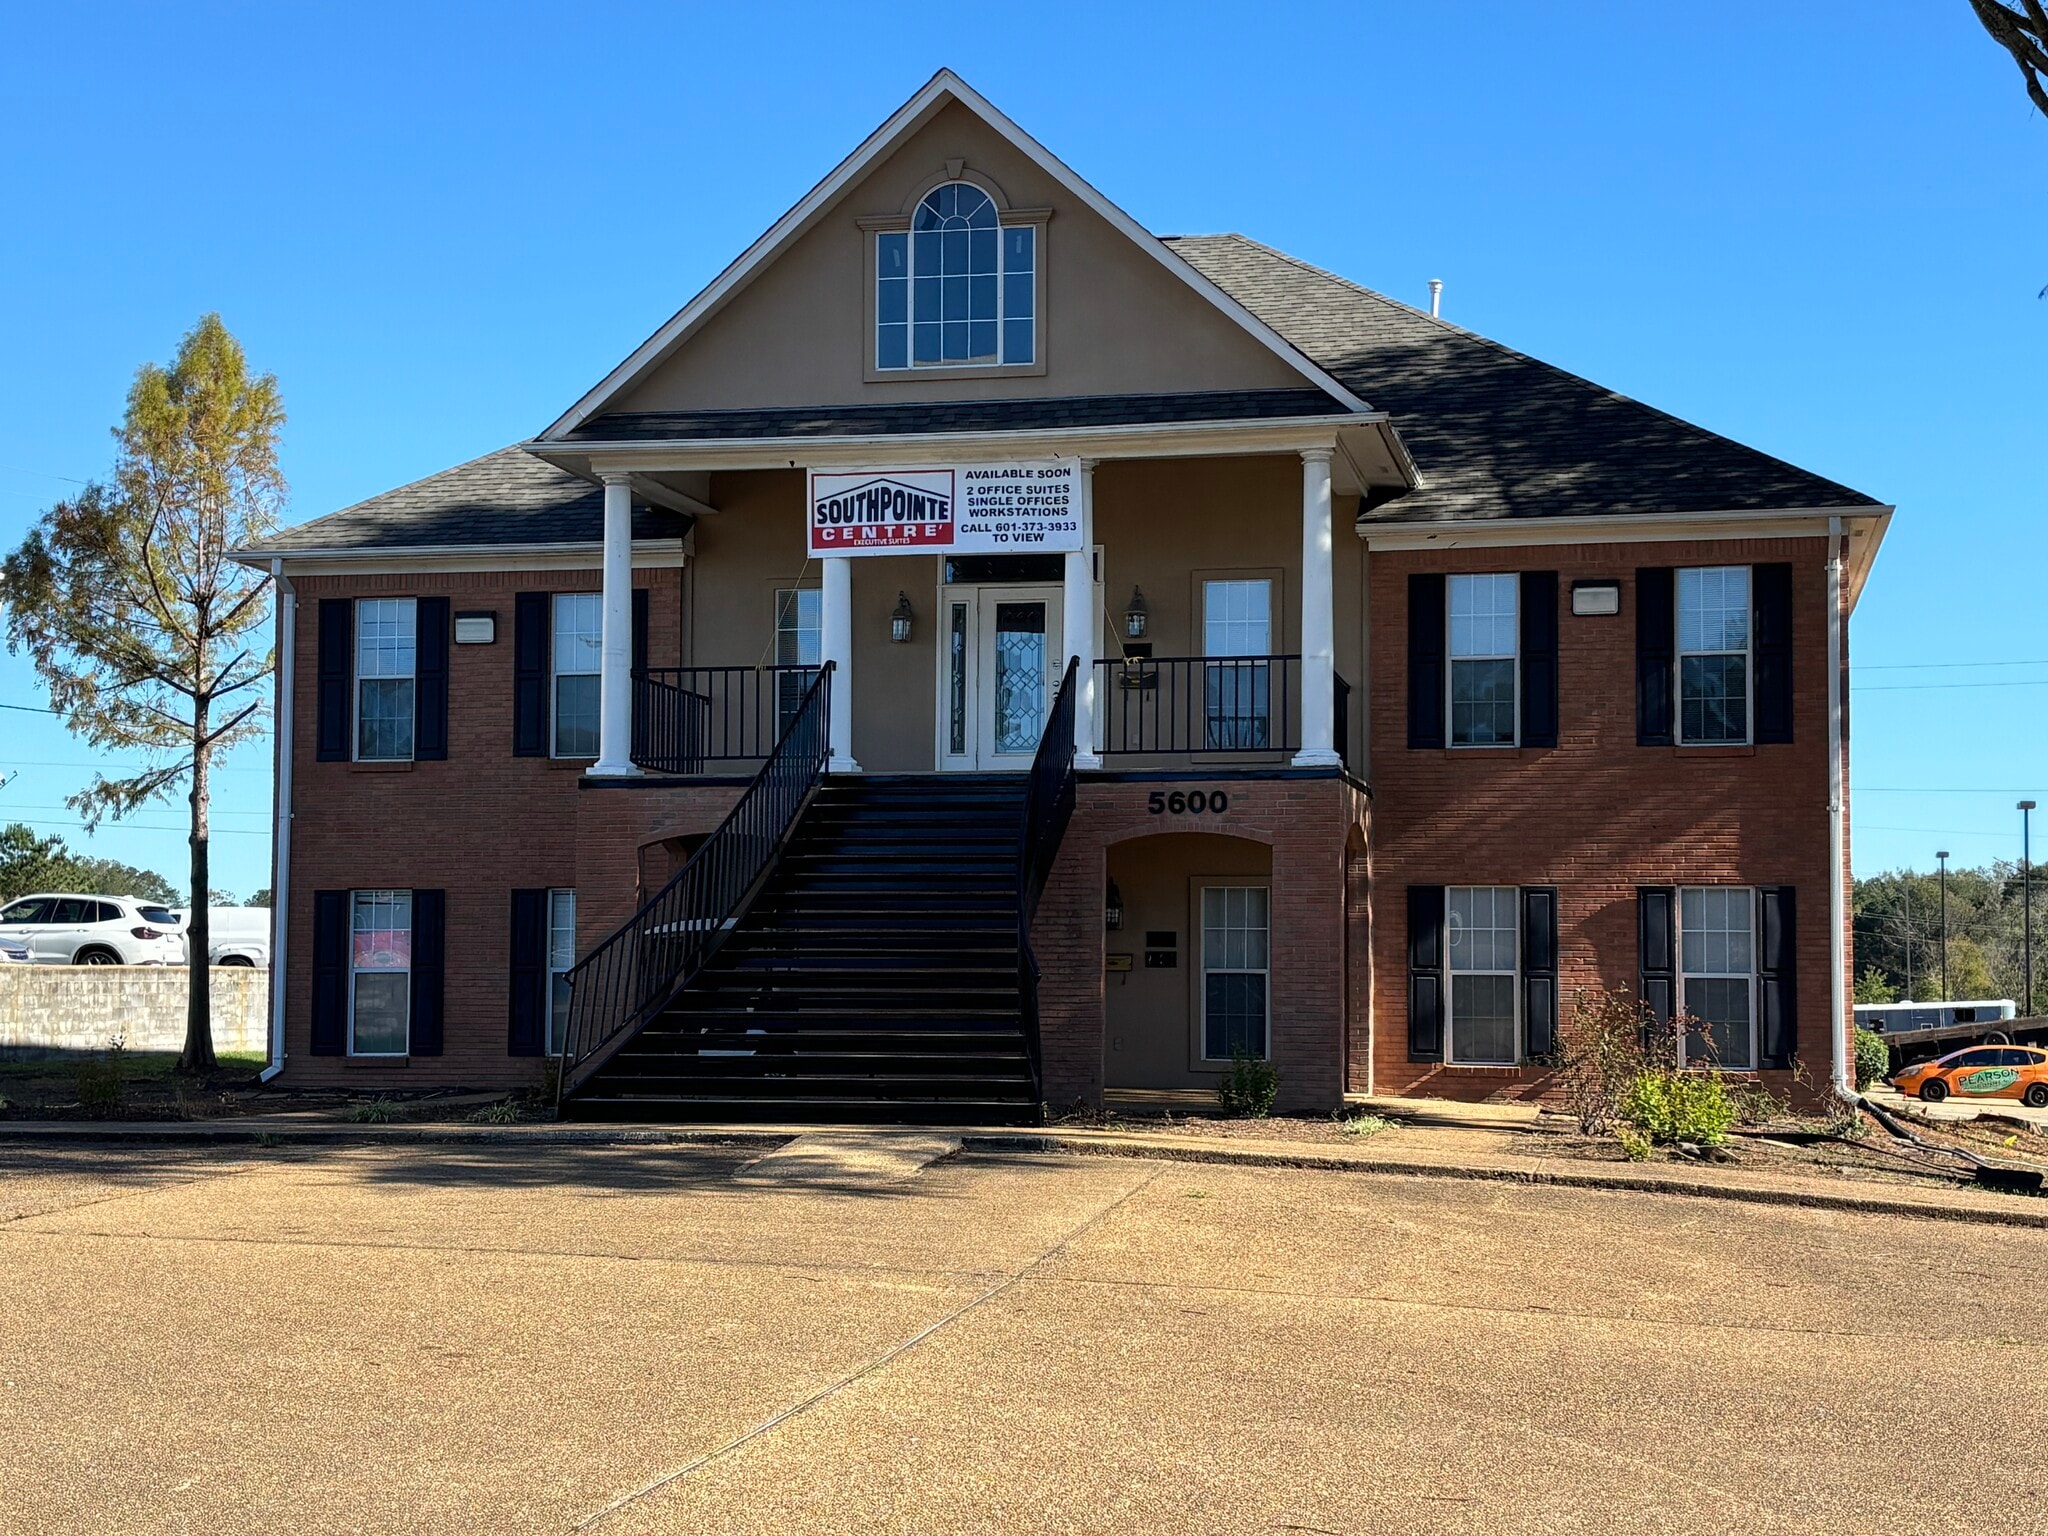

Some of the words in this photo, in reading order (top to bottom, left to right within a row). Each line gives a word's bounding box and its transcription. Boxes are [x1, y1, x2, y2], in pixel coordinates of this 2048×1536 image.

[965, 470, 1033, 480] AVAILABLE
[1037, 468, 1071, 478] SOON
[967, 486, 973, 495] 2
[978, 485, 1022, 495] OFFICE
[1026, 484, 1070, 494] SUITES
[817, 486, 949, 524] SOUTHPOINTE
[968, 496, 1013, 506] SINGLE
[1017, 495, 1069, 505] OFFICES
[969, 507, 1068, 517] WORKSTATIONS
[961, 523, 992, 532] CALL
[995, 521, 1077, 531] 601-373-3933
[854, 538, 887, 546] EXECUTIVE
[888, 537, 910, 545] SUITES
[992, 533, 1009, 542] TO
[1012, 532, 1044, 542] VIEW
[1148, 790, 1228, 815] 5600
[1957, 1067, 2020, 1087] PEARSON
